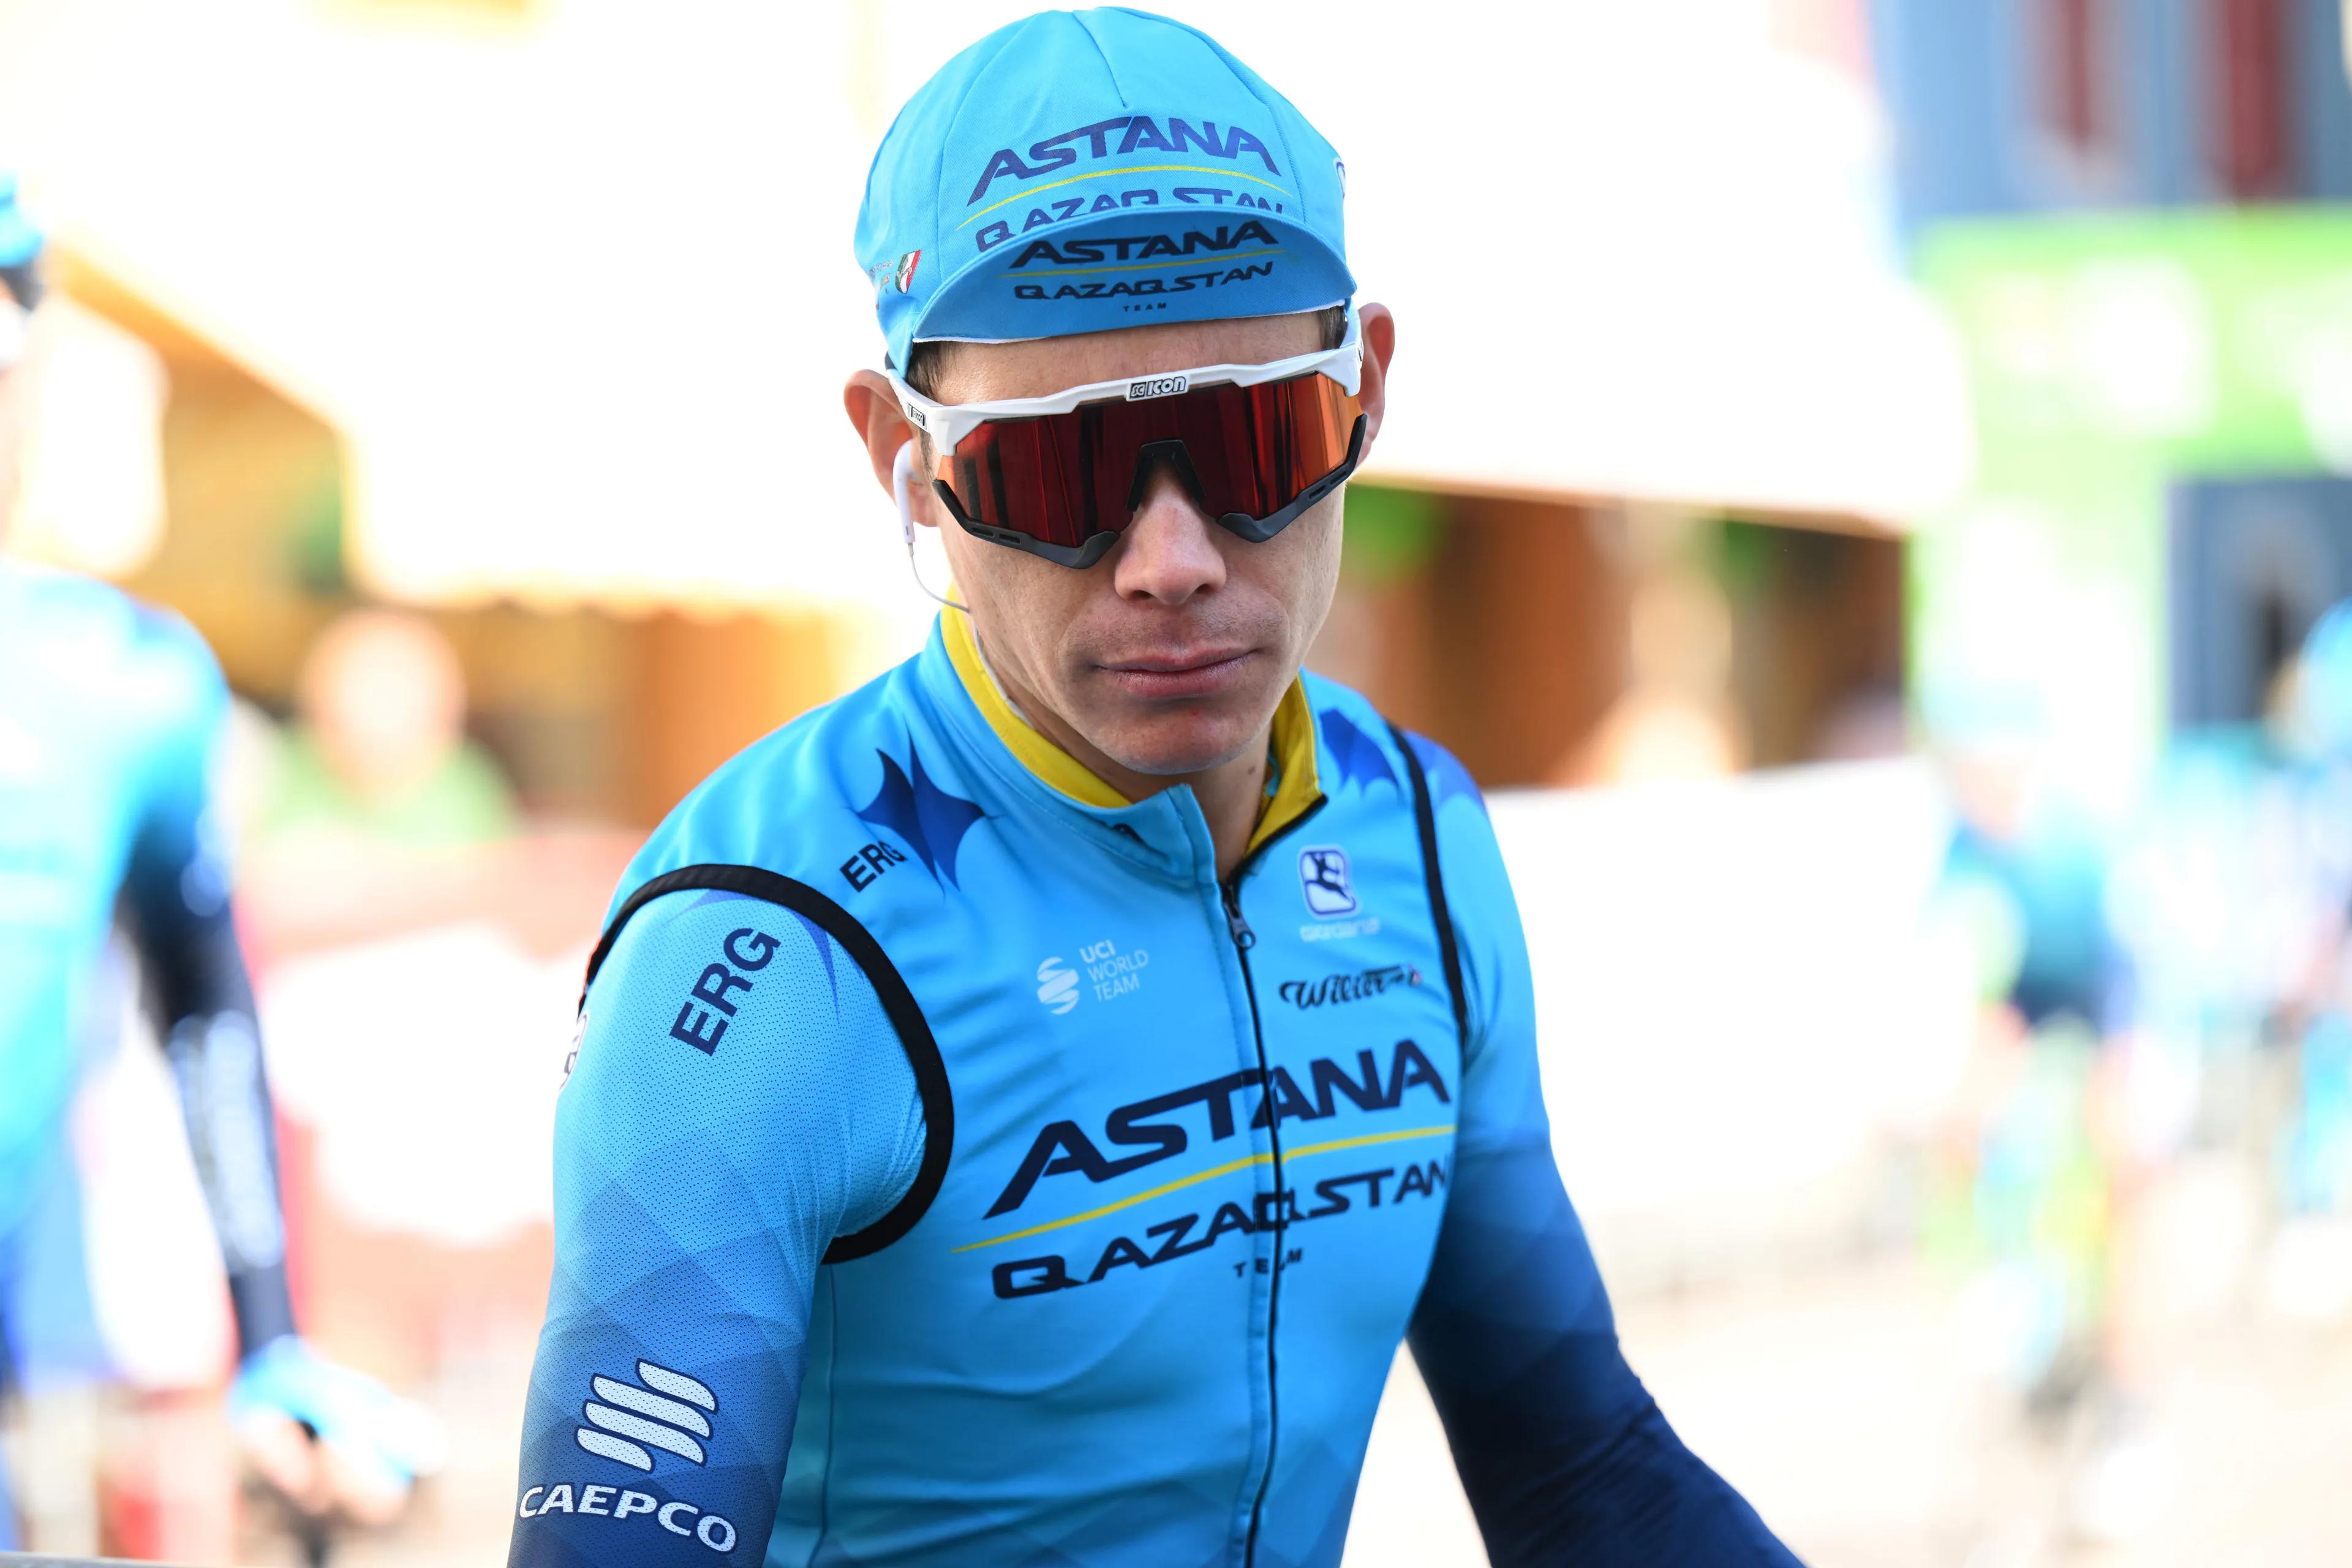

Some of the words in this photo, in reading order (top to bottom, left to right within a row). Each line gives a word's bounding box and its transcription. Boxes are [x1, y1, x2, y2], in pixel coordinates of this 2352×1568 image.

[968, 116, 1281, 206] ASTANA
[1009, 221, 1279, 269] ASTANA
[1014, 262, 1273, 300] QAZAQSTAN
[1123, 303, 1167, 312] TEAM
[840, 840, 907, 892] ERG
[1079, 940, 1116, 963] UCI
[1087, 950, 1149, 982] WORLD
[669, 928, 782, 1057] ERG
[1093, 973, 1140, 1002] TEAM
[982, 1039, 1450, 1220] ASTANA
[518, 1483, 736, 1553] CAEPCO
